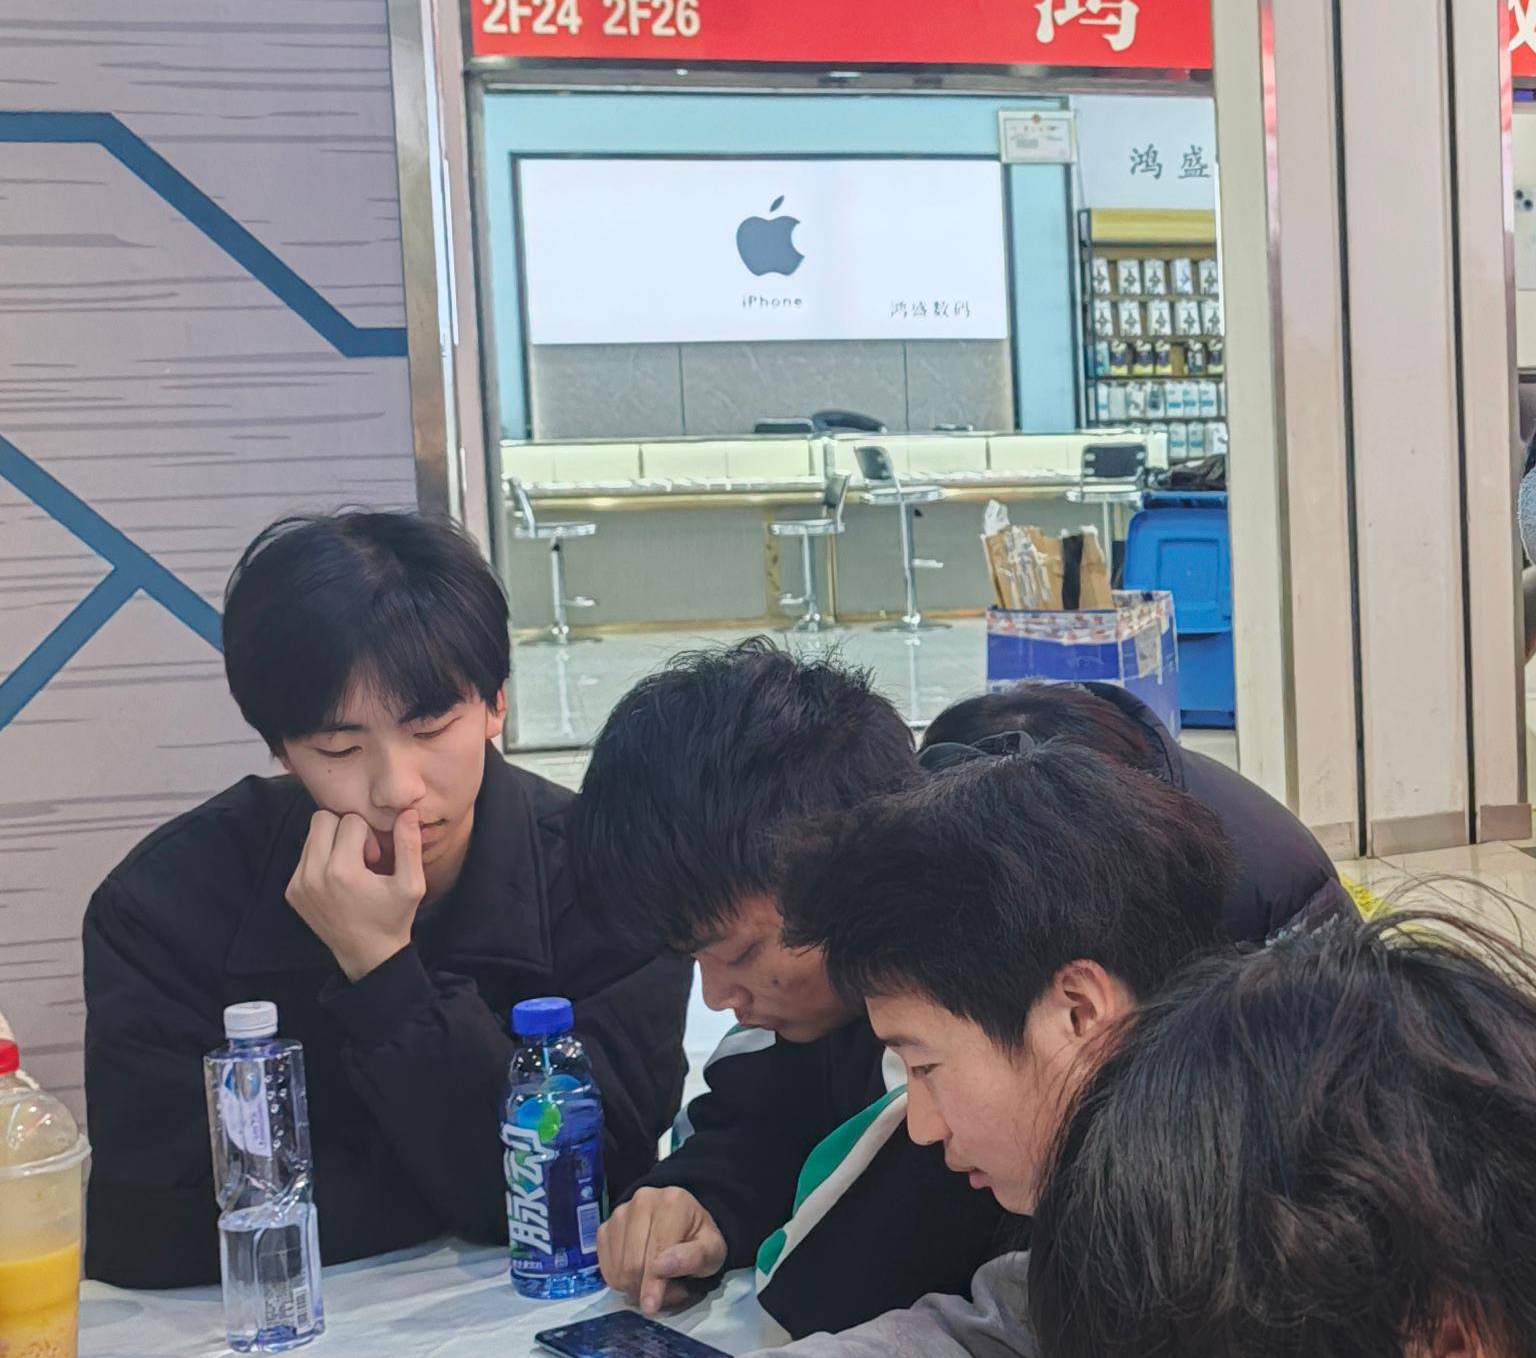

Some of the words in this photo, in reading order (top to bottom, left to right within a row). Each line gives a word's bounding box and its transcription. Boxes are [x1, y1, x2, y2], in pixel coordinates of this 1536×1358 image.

[1130, 143, 1212, 180] 鸿盛
[742, 294, 802, 308] iPhone
[501, 1122, 560, 1255] 脉动
